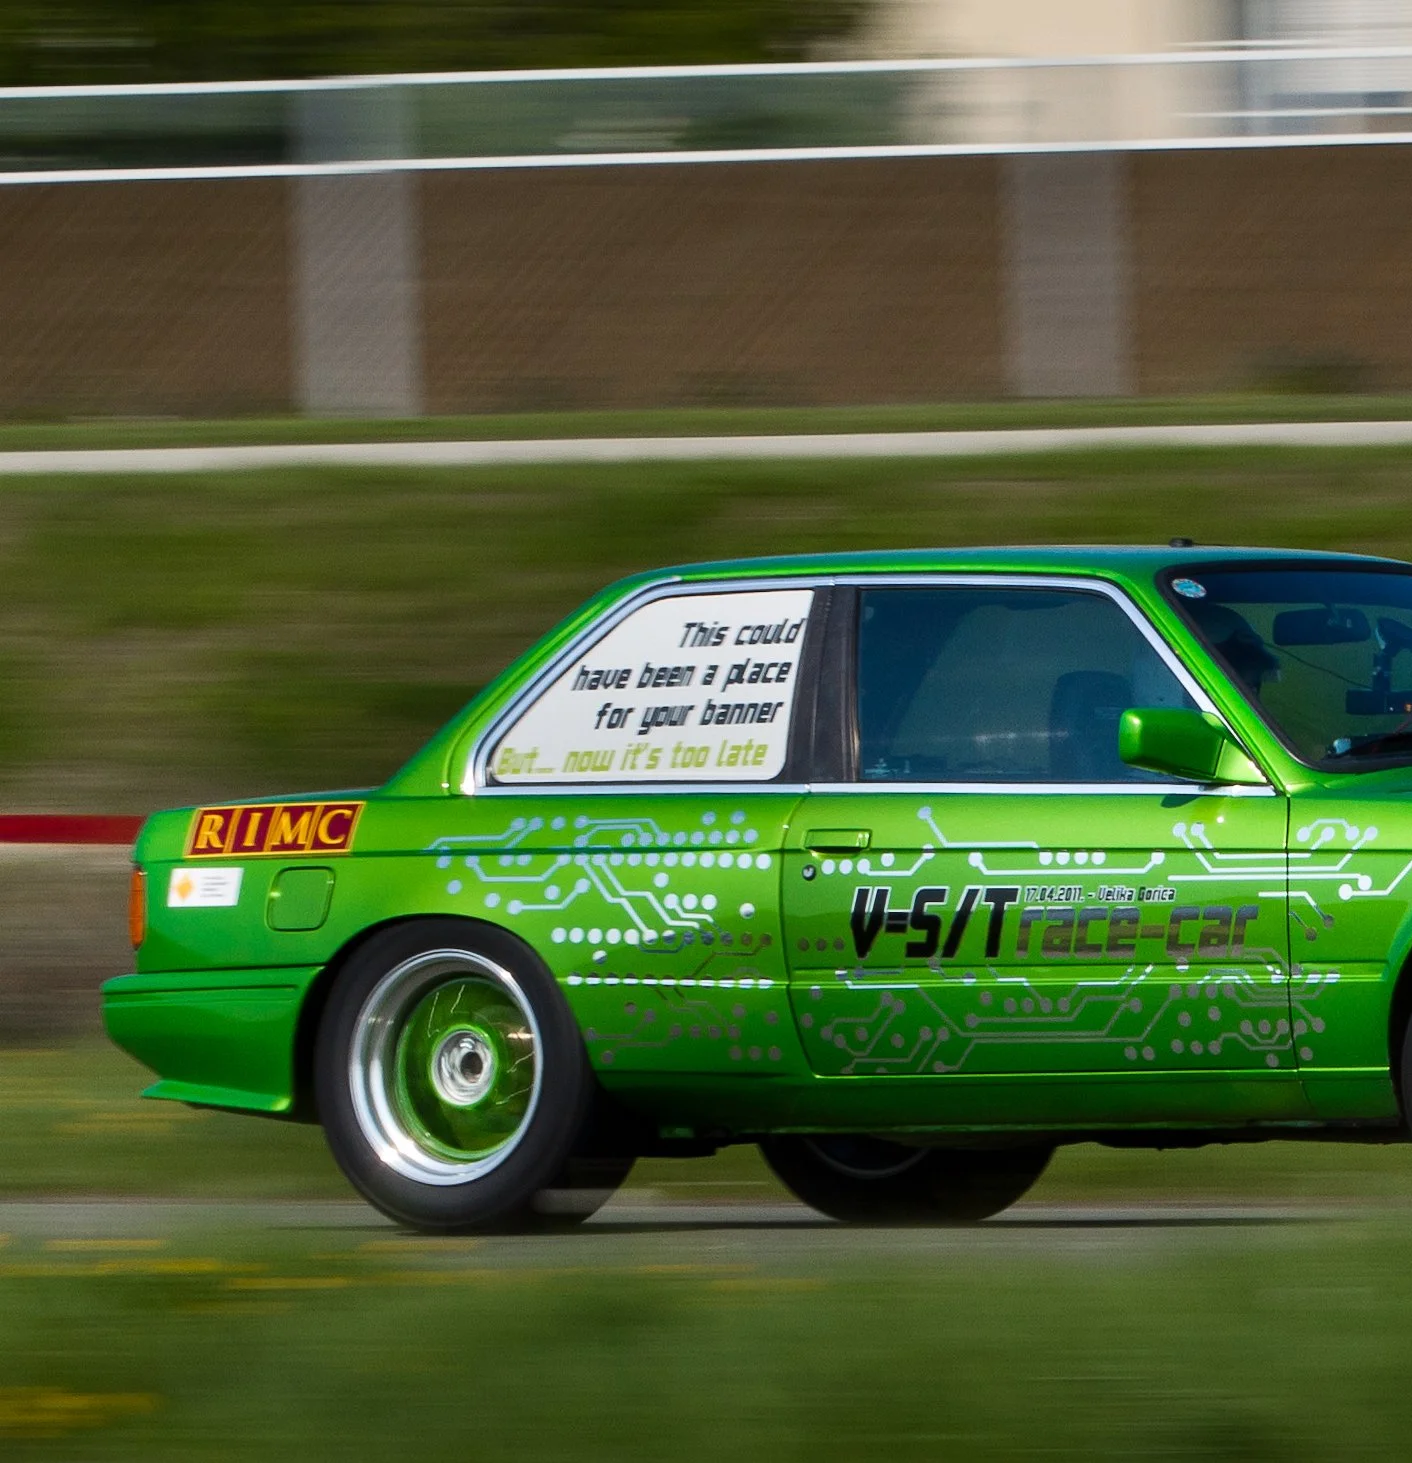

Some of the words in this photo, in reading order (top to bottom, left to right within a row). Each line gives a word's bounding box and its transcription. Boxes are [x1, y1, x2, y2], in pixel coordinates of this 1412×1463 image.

[680, 621, 728, 648] This
[734, 618, 805, 646] could
[571, 665, 632, 691] have
[636, 662, 695, 689] been
[702, 664, 718, 686] a
[721, 658, 792, 692] place
[595, 702, 634, 729] for
[637, 703, 694, 735] your
[698, 699, 784, 726] banner
[496, 747, 555, 775] But...
[562, 749, 616, 773] now
[620, 743, 663, 770] it's
[670, 741, 711, 769] too
[716, 738, 769, 768] late
[194, 808, 353, 850] RIMC
[1098, 885, 1135, 902] Velika
[1138, 885, 1176, 902] Gorica
[1016, 905, 1259, 958] race-car
